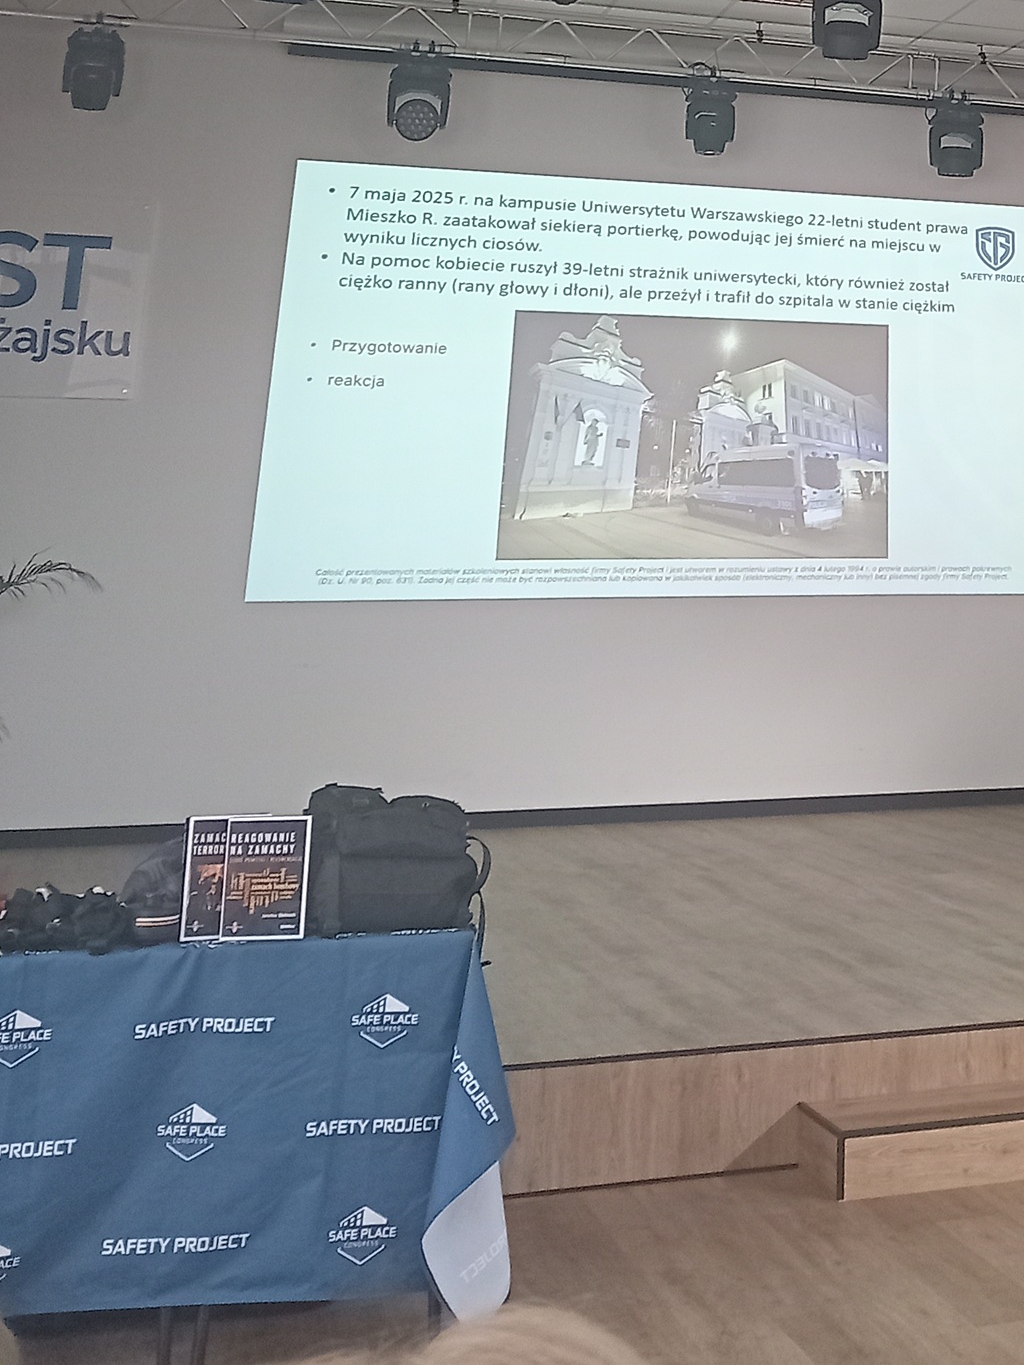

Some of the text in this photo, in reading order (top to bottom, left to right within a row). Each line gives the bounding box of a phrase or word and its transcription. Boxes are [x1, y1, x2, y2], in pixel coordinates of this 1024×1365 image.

[349, 186, 968, 235] 7 maja 2025 r. na kampusie Uniwersytetu Warszawskiego 22-letni student prawa
[346, 208, 941, 253] Mieszko R. zaatakował siekierą portierkę, powodując jej śmierć na miejscu w
[344, 231, 543, 252] wyniku licznych ciosów.
[342, 252, 949, 293] Na pomoc kobiecie ruszył 39-letni strażnik uniwersytecki, który również został
[961, 272, 993, 281] SAFETY
[339, 275, 955, 314] ciężko ranny (rany głowy i dłoni), ale przeżył i trafił do szpitala w stanie ciężkim
[332, 340, 447, 355] Przygotowanie
[328, 375, 385, 390] reakcja
[612, 566, 637, 575] Safety
[638, 566, 664, 575] Project
[230, 832, 296, 844] REAGOWANIE
[230, 844, 296, 855] NA ZAMACHY
[351, 1013, 419, 1026] SAFE PLACE
[12, 1029, 52, 1043] PLACE
[134, 1017, 276, 1040] SAFETY PROJECT
[453, 1060, 499, 1126] PROJECT
[157, 1124, 227, 1137] SAFE PLACE
[305, 1115, 442, 1137] SAFETY PROJECT
[0, 1138, 78, 1159] PROJECT
[172, 1137, 209, 1145] CONGRESS
[328, 1226, 398, 1243] SAFE PLACE
[101, 1233, 251, 1256] SAFETY PROJECT
[343, 1240, 380, 1249] CONGRESS
